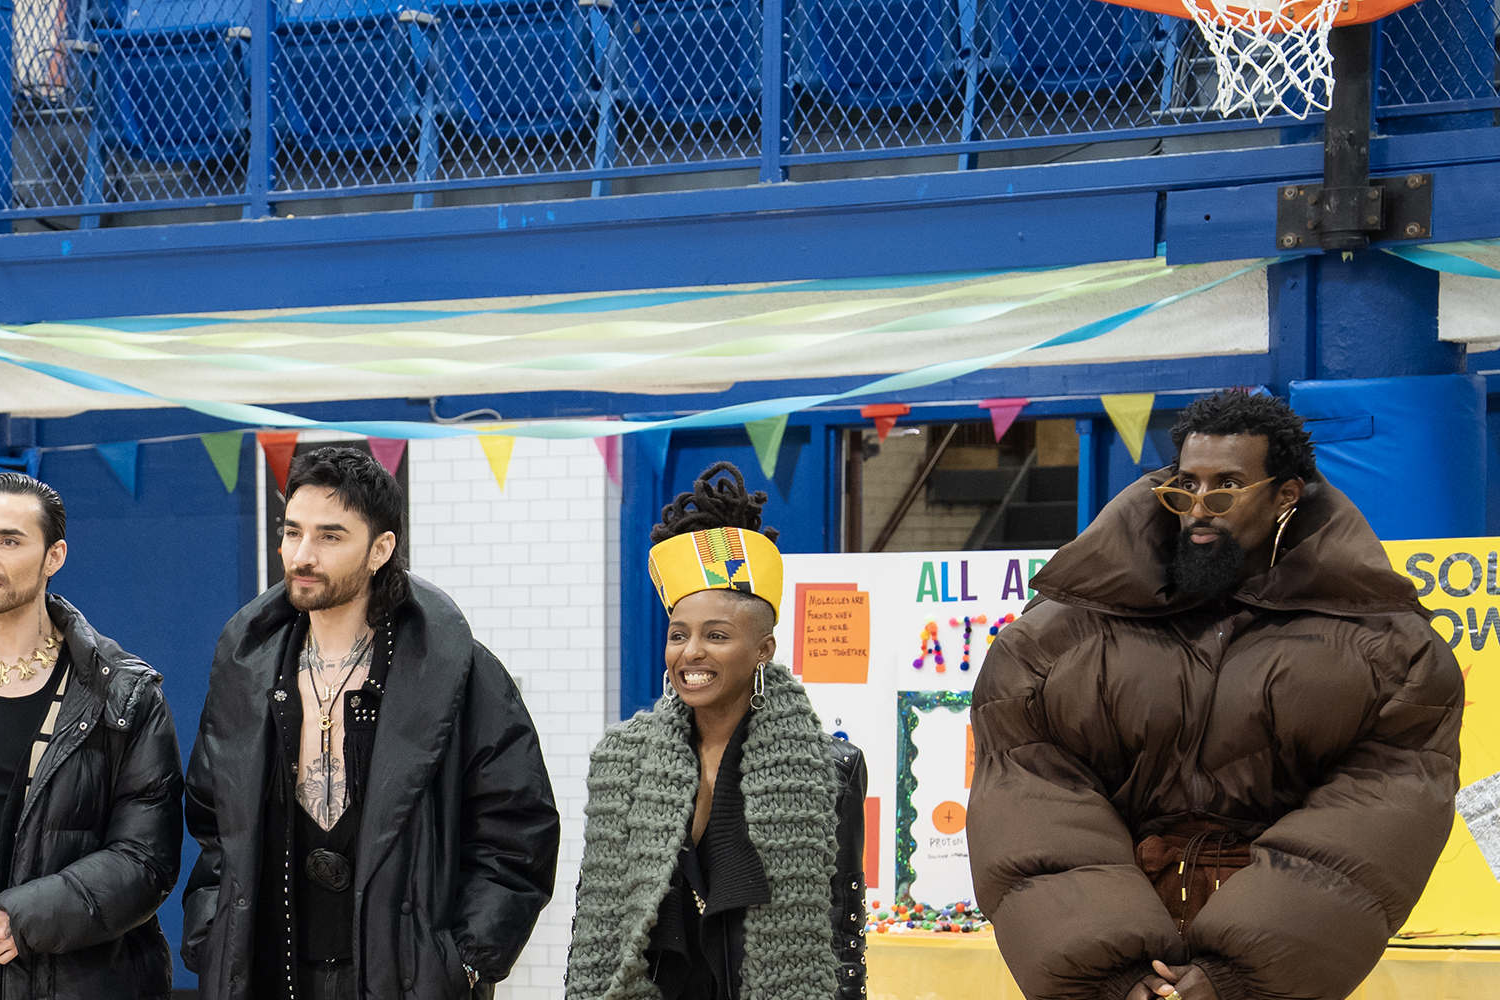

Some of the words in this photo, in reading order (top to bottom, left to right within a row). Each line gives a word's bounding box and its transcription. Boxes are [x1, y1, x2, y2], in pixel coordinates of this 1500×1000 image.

[1406, 551, 1500, 597] SOL
[916, 560, 978, 602] ALL
[809, 595, 850, 606] MOLECULES
[852, 596, 864, 604] ARE
[808, 610, 832, 619] FORMED
[835, 611, 852, 619] WHEN
[807, 625, 814, 633] 2
[832, 636, 849, 644] ARE
[809, 649, 828, 657] HELD
[833, 648, 867, 657] TOGETHER
[929, 837, 963, 848] PROTON
